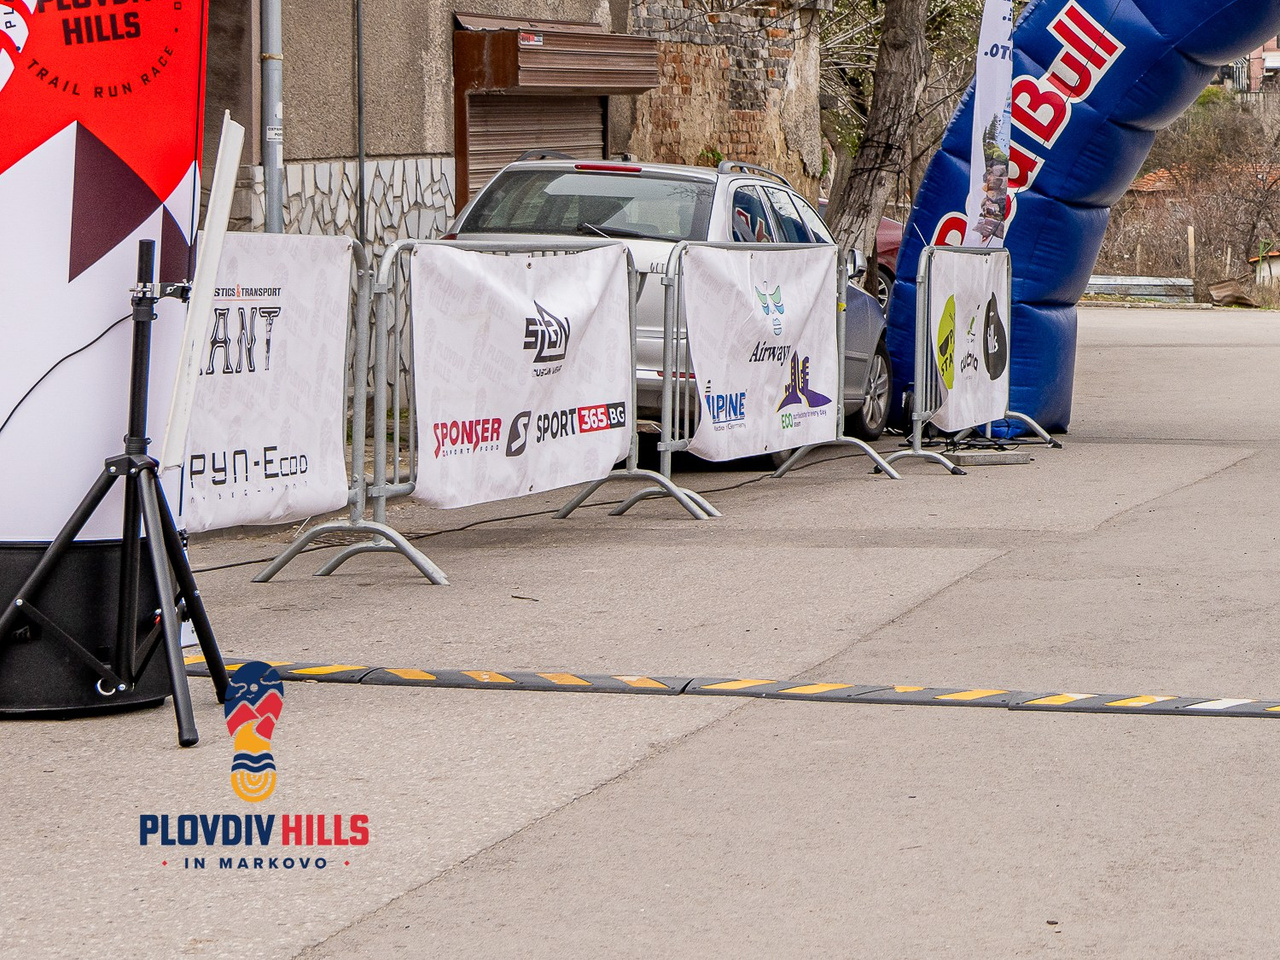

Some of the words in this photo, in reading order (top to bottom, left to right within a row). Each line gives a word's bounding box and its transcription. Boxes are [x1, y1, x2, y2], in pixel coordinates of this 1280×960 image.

[62, 11, 141, 46] HILLS
[26, 58, 81, 97] TRAIL
[94, 83, 133, 99] RUN
[141, 44, 174, 87] RACE
[1012, 5, 1119, 143] Bull
[241, 287, 282, 297] TRANSPORT
[200, 306, 281, 375] ANT
